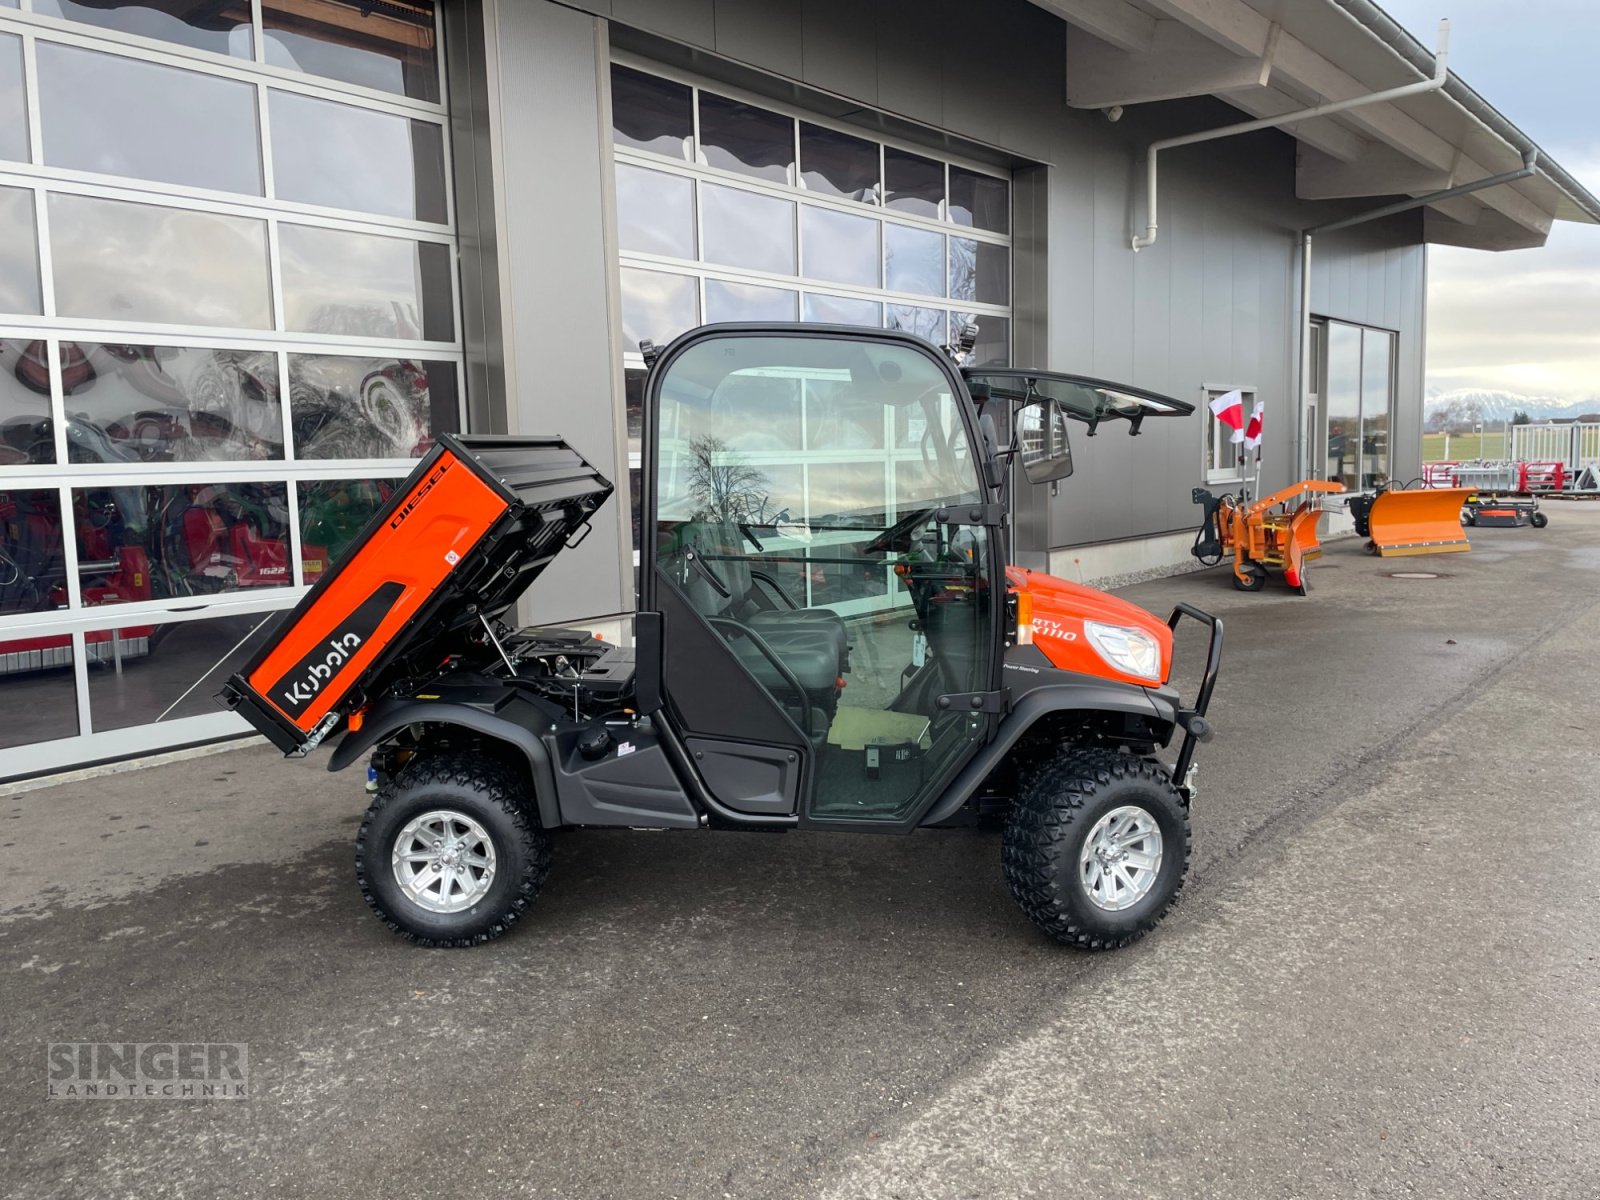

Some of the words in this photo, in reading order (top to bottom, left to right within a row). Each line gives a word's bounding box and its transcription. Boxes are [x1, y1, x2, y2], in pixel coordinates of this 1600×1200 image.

[390, 461, 455, 529] DIESEL
[259, 567, 286, 576] 1622
[1032, 617, 1061, 629] RTV
[1032, 625, 1078, 641] X1110
[284, 632, 361, 705] Kubota
